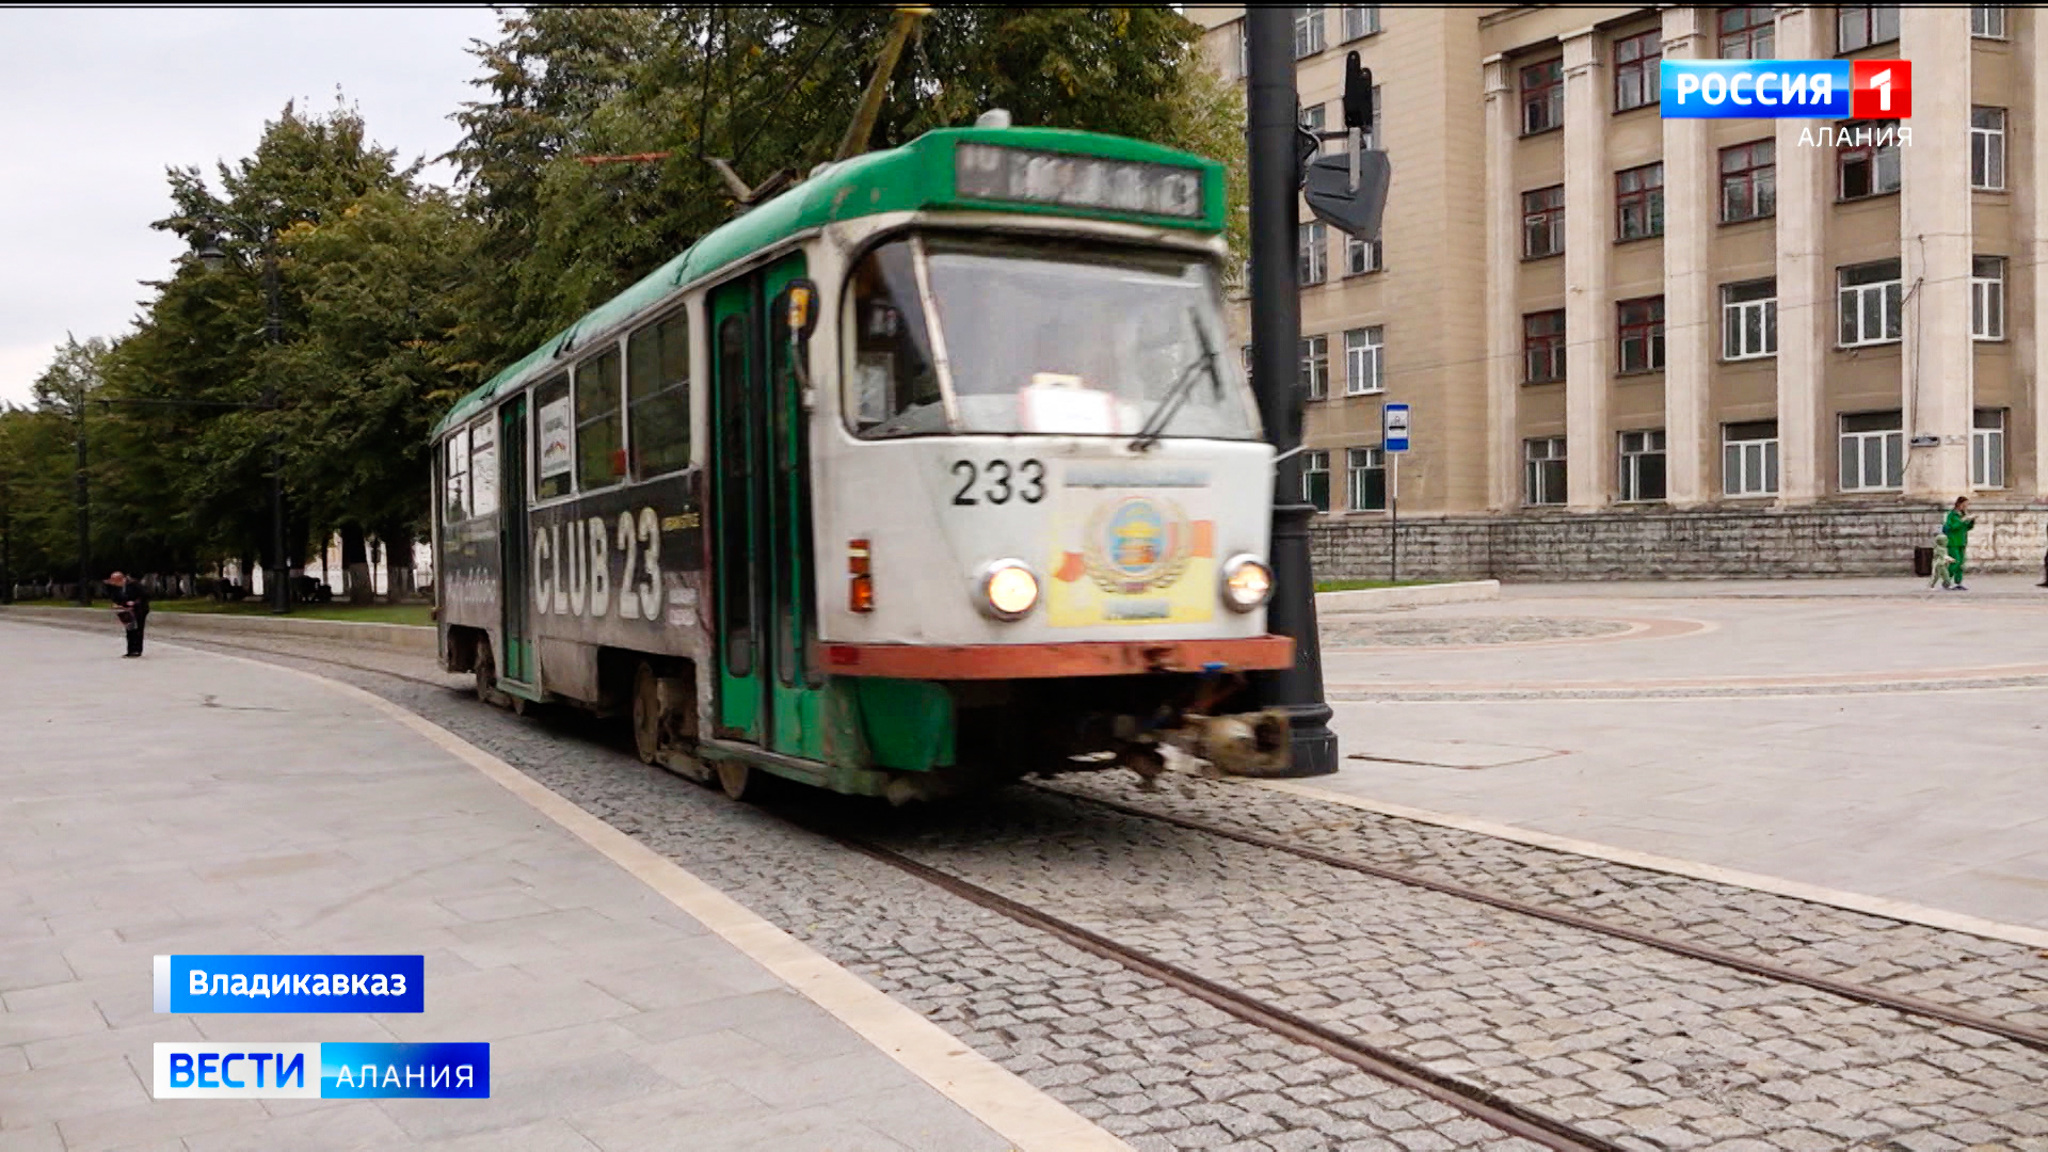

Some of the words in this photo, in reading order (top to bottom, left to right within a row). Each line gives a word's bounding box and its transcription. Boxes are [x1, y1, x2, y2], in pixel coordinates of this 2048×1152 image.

[951, 458, 1047, 506] 233
[534, 516, 611, 617] CLUB
[618, 506, 662, 621] 23
